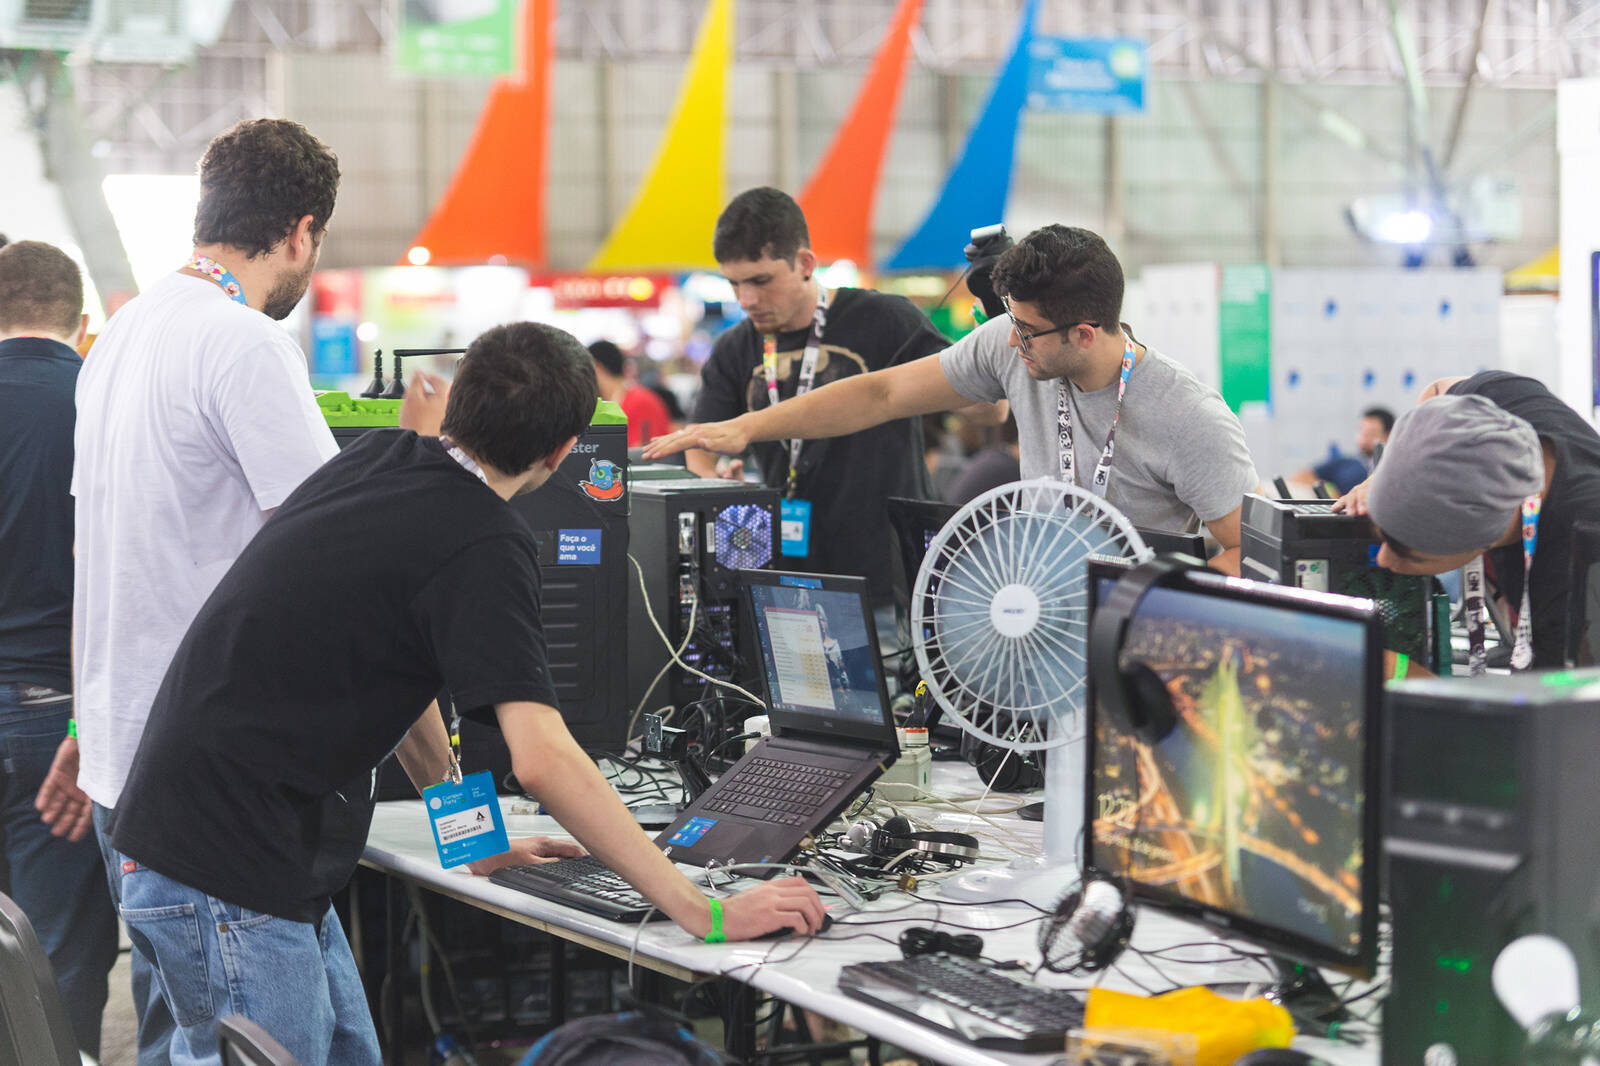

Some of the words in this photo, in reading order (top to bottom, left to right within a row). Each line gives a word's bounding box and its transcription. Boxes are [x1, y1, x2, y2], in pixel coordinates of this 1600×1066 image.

[560, 534, 579, 543] Faça
[559, 544, 576, 553] que
[576, 543, 596, 552] você
